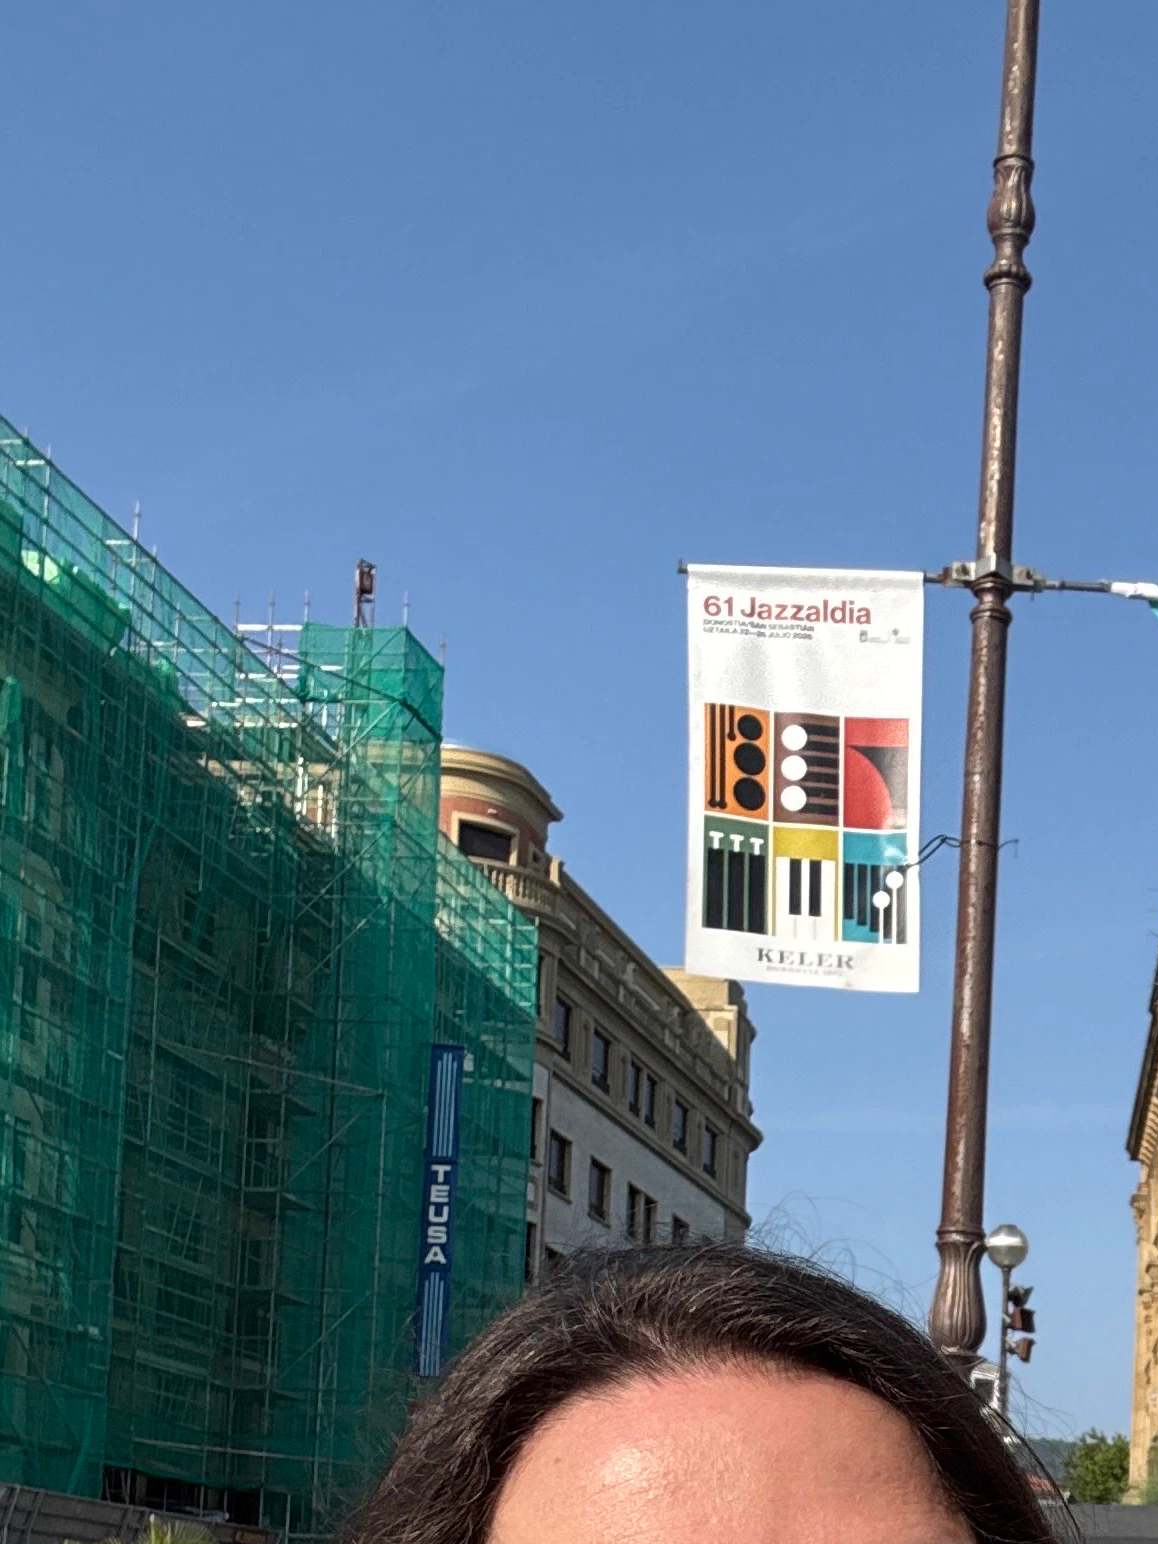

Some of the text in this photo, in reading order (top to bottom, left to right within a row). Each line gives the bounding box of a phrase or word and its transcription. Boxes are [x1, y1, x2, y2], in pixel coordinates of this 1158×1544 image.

[703, 595, 872, 624] 61 Jazzaldia
[757, 948, 854, 969] KELER
[424, 1164, 452, 1265] TEUSA
